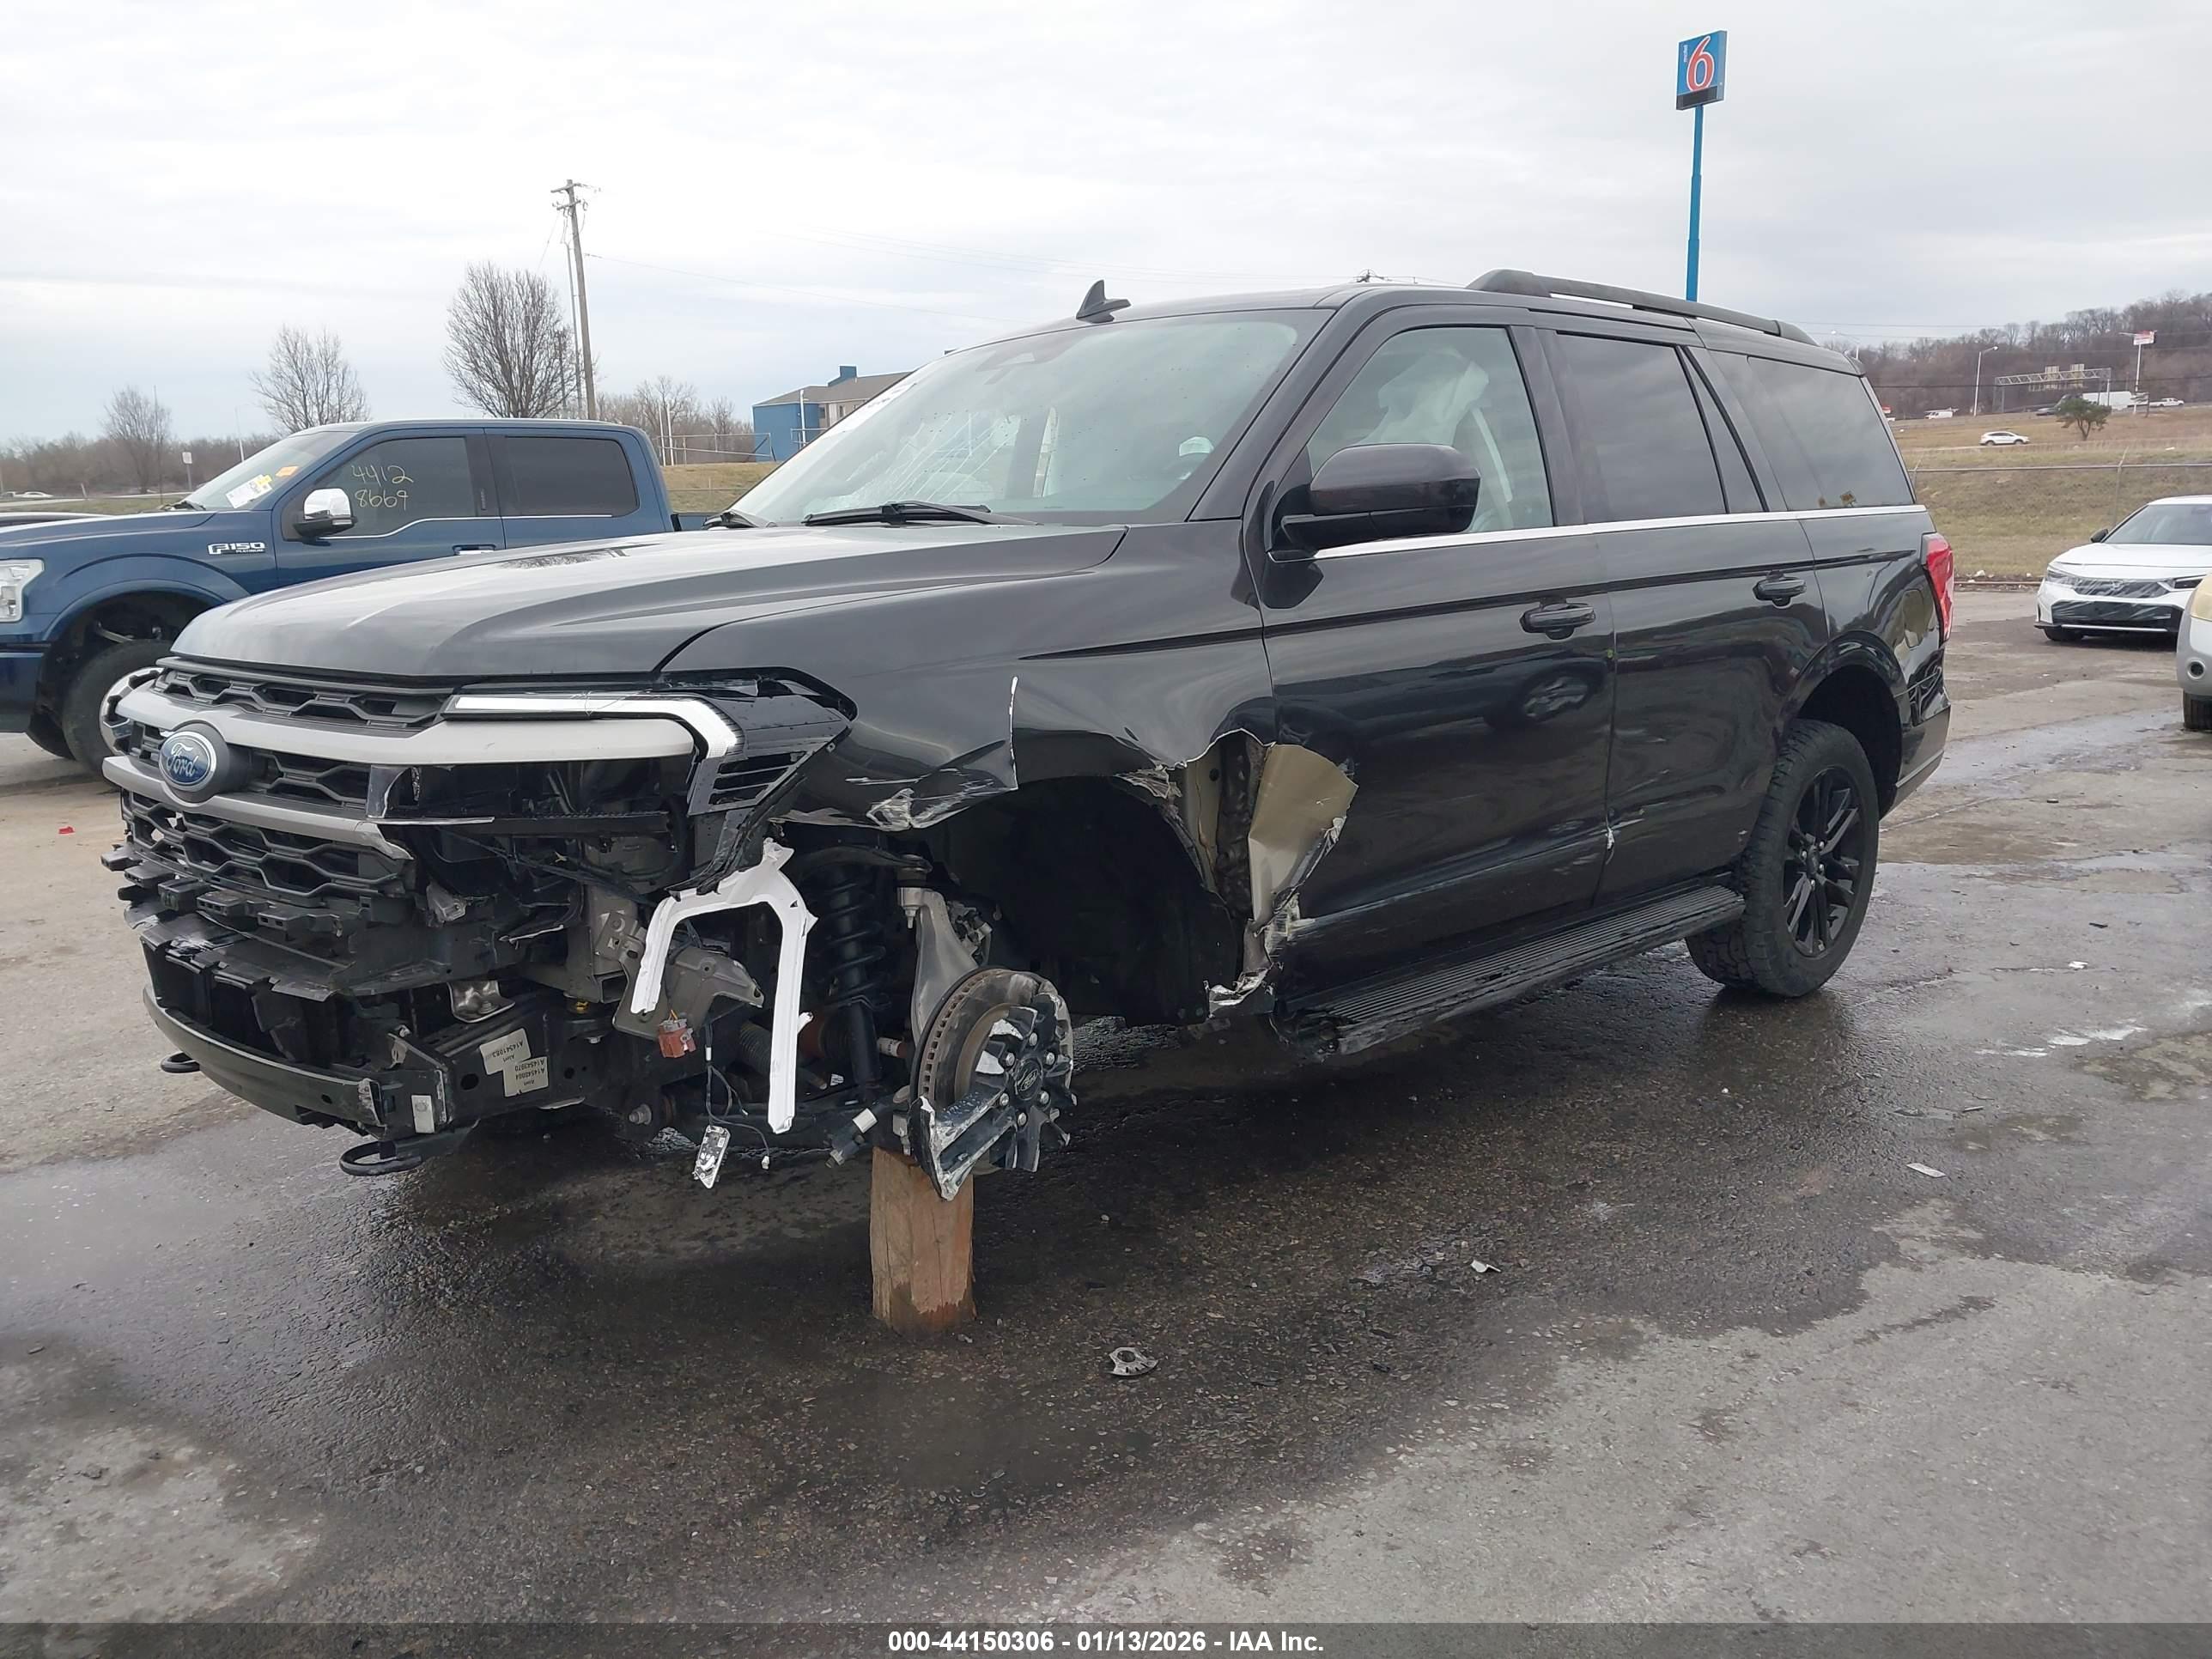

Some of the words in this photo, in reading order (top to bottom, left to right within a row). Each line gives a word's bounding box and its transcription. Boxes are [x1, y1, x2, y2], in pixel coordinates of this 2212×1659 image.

[1686, 35, 1714, 91] 6
[351, 465, 414, 487] 4412
[355, 489, 409, 511] 8669
[166, 742, 199, 777] Ford
